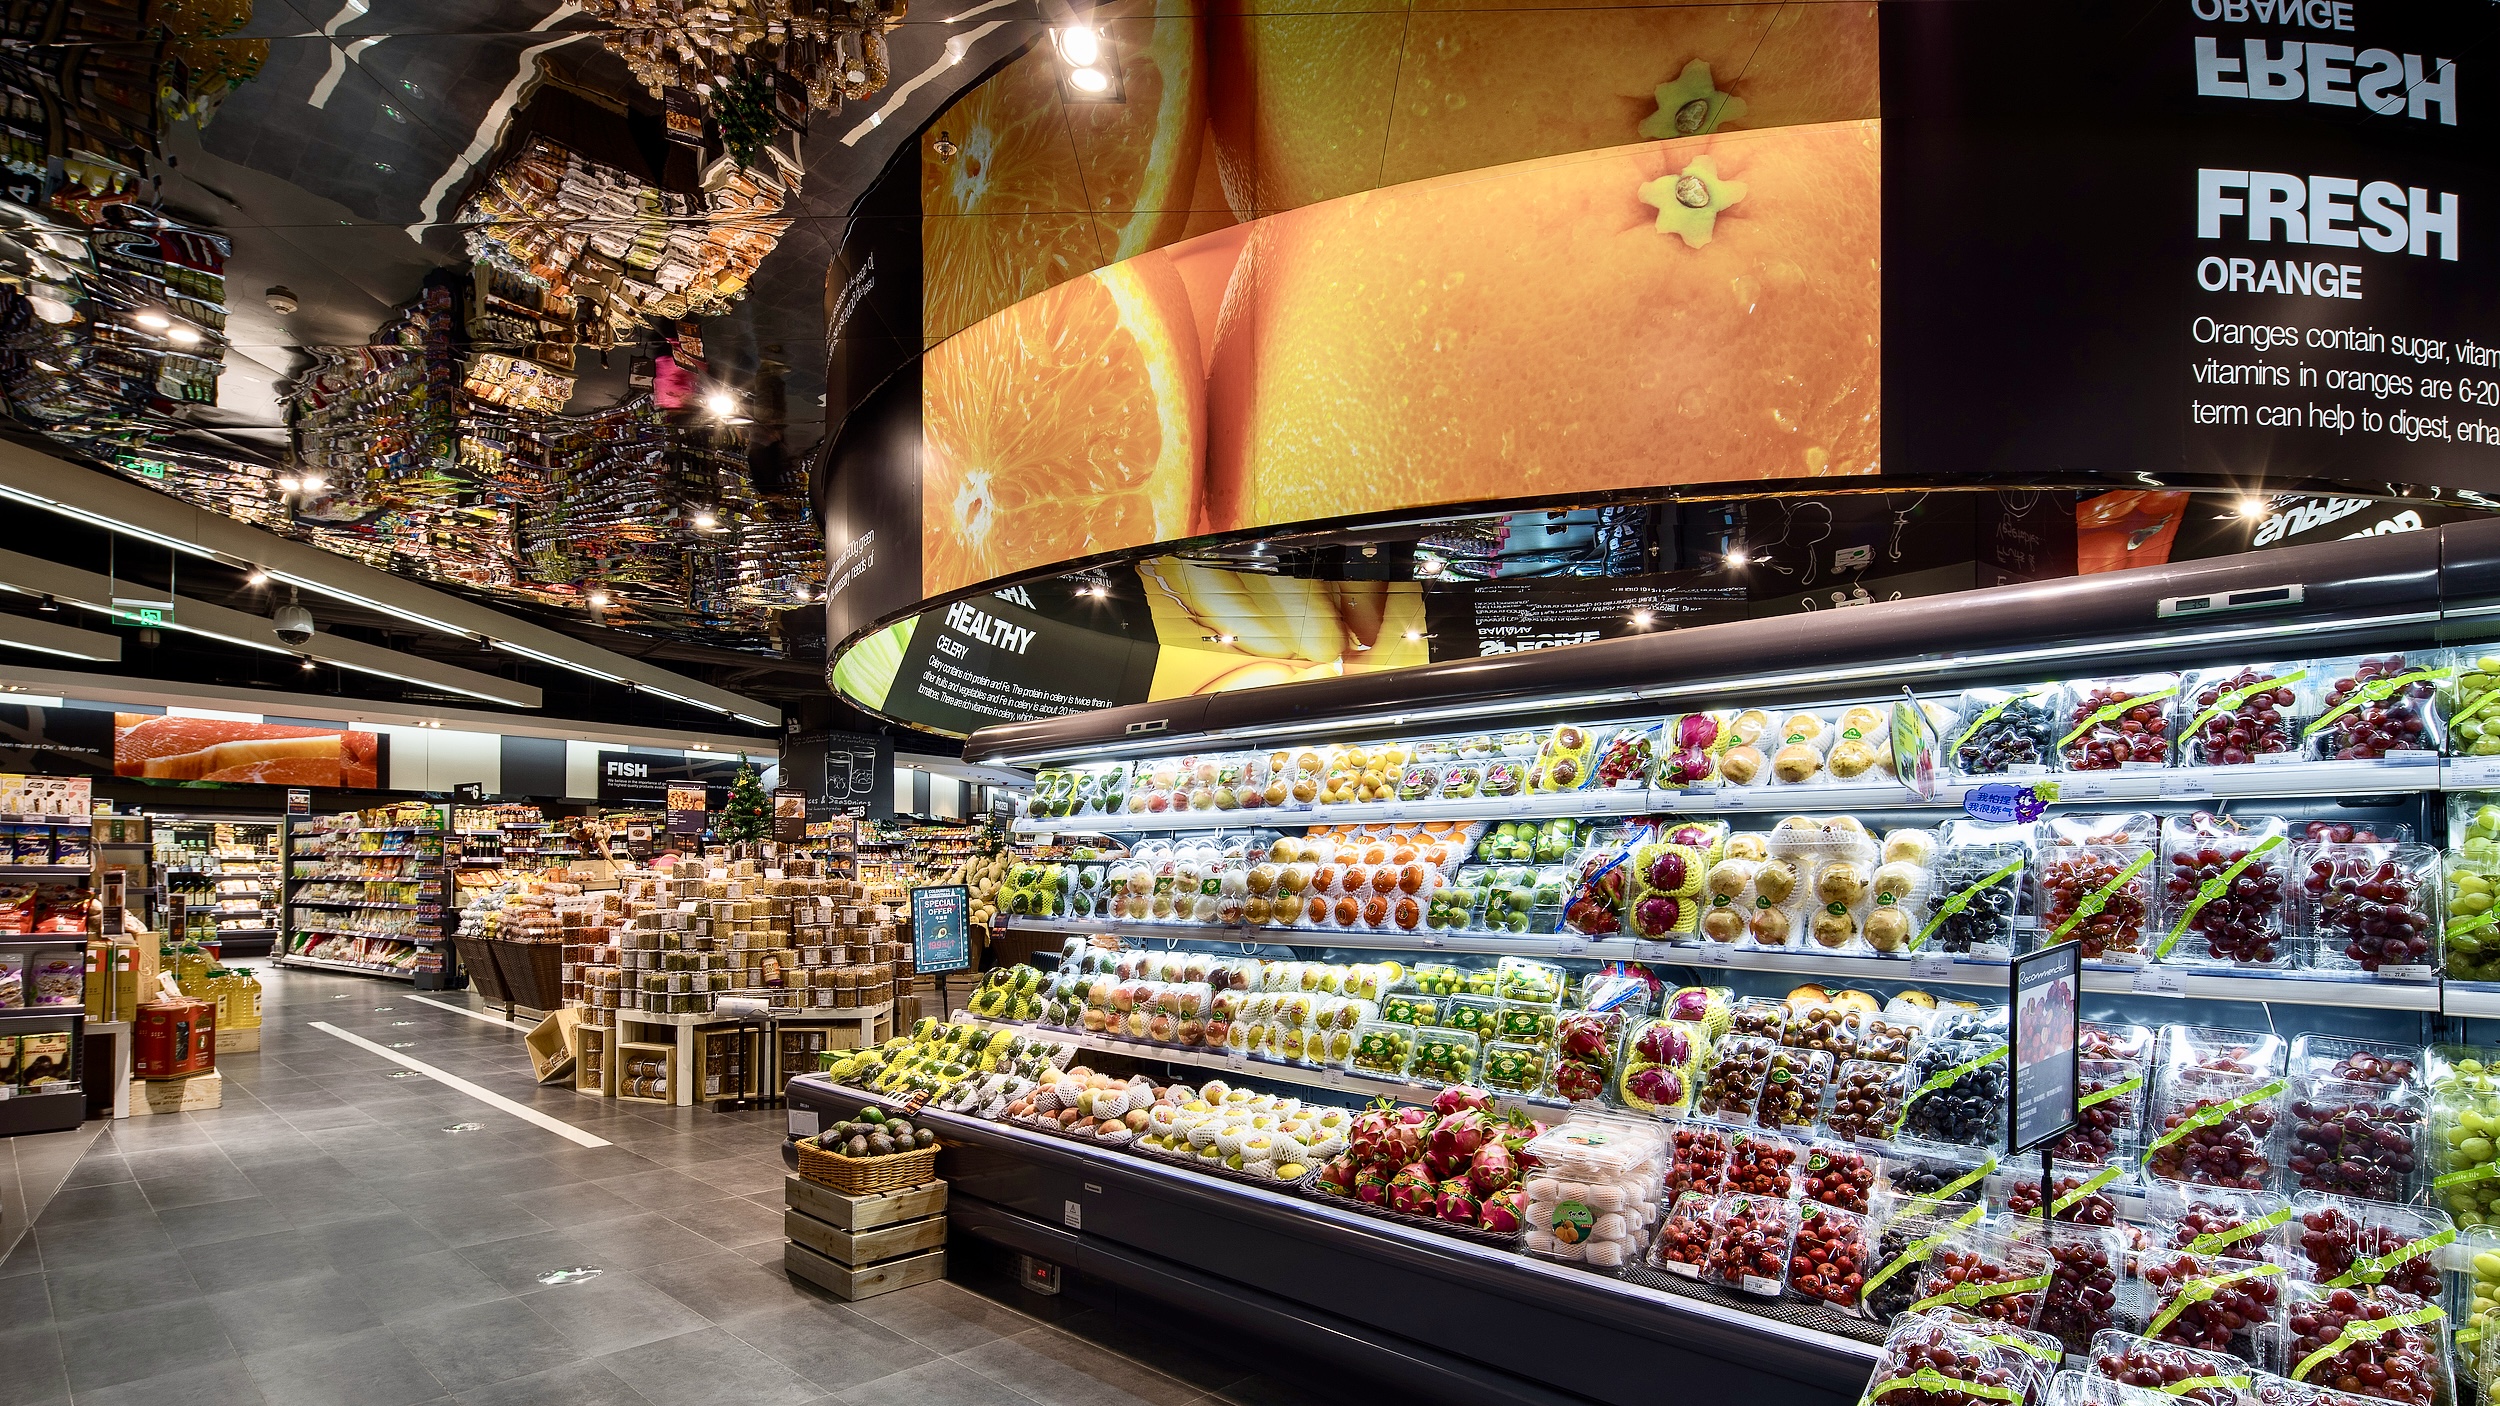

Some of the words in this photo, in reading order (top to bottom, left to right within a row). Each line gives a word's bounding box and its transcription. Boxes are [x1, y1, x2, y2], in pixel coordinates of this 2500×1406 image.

[2198, 168, 2458, 261] FRESH
[2197, 256, 2362, 300] ORANGE
[2192, 316, 2299, 351] Oranges
[2306, 326, 2385, 353] contain
[2391, 335, 2450, 365] sugar,
[2192, 358, 2290, 386] vitamins
[2300, 361, 2317, 387] in
[2326, 369, 2413, 399] oranges
[2420, 379, 2452, 400] are
[2459, 378, 2499, 407] 6-20
[2192, 400, 2248, 425] term
[2256, 406, 2301, 426] can
[2309, 402, 2355, 436] help
[2361, 408, 2383, 432] to
[2389, 409, 2452, 443] digest,
[858, 529, 875, 554] green
[851, 557, 867, 579] needs
[867, 549, 875, 568] of
[944, 601, 1037, 655] HEALTHY
[935, 634, 969, 660] CELERY
[922, 670, 936, 682] other
[935, 674, 949, 689] fruits
[948, 681, 960, 692] and
[959, 685, 987, 701] vegetables
[987, 694, 1000, 704] and
[999, 695, 1008, 706] Fe
[1007, 697, 1014, 706] in
[1014, 699, 1035, 712] celery
[1033, 702, 1040, 711] is
[1039, 704, 1058, 714] about
[1058, 706, 1068, 715] 20
[928, 654, 944, 672] Celery
[962, 670, 973, 681] rich
[971, 675, 990, 687] protein
[989, 680, 1003, 690] and
[1012, 683, 1023, 695] The
[1022, 687, 1043, 699] protein
[1043, 691, 1049, 700] in
[1050, 692, 1068, 705] celery
[1067, 695, 1074, 704] is
[1074, 696, 1091, 706] twice
[1091, 698, 1106, 708] than
[1106, 699, 1113, 708] in
[918, 682, 940, 700] tomatoes.
[940, 691, 955, 706] There
[953, 697, 963, 707] are
[962, 699, 972, 710] rich
[971, 701, 993, 715] vitamins
[993, 706, 999, 716] in
[998, 709, 1016, 721] celery,
[1017, 712, 1034, 721] which
[607, 761, 648, 778] FISH
[472, 785, 479, 800] 6
[1976, 792, 2012, 806] 我怕捏
[859, 805, 866, 817] 8
[1968, 802, 2014, 817] 我很娇气
[924, 899, 956, 908] SPECIAL
[2467, 921, 2477, 929] life
[2018, 956, 2069, 985] Recommended
[2468, 1171, 2480, 1179] life
[1864, 1279, 1877, 1292] Enjoy
[1894, 1261, 1902, 1271] life
[1891, 1380, 1902, 1388] life
[1916, 1375, 1931, 1385] Fresh
